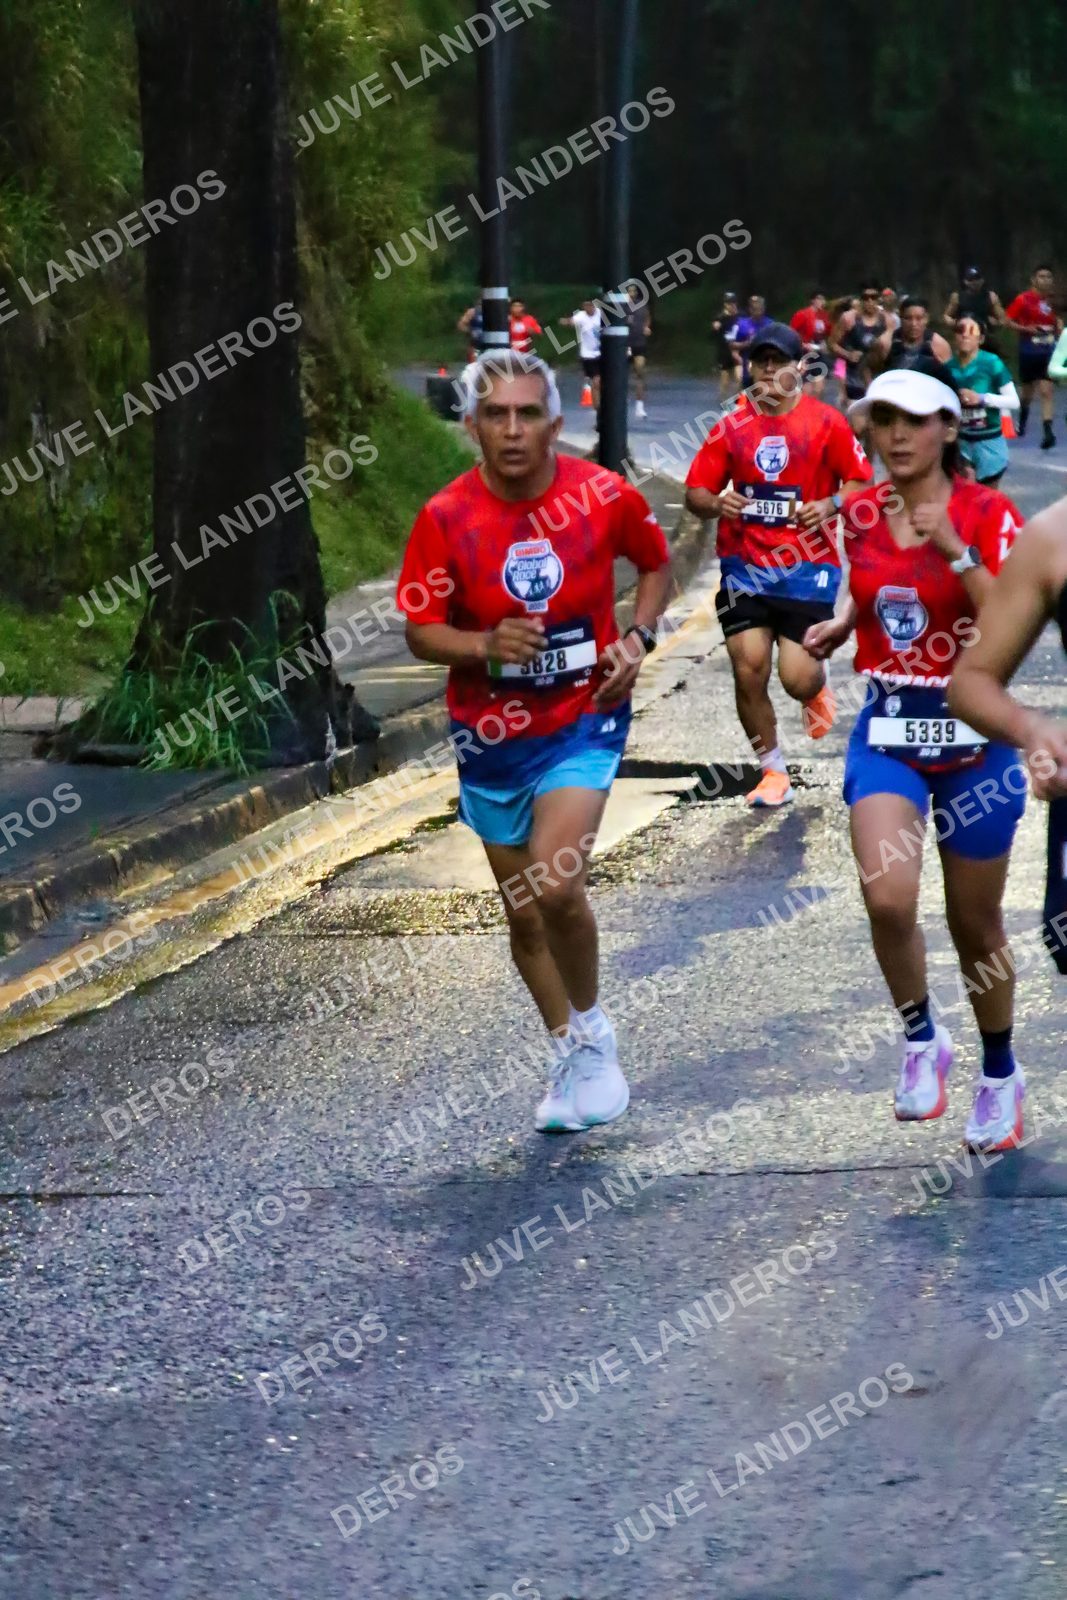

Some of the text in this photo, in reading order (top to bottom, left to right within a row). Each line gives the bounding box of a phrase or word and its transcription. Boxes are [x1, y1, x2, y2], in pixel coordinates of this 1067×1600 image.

[756, 501, 783, 515] 5676
[517, 558, 547, 571] Global
[512, 569, 537, 581] Race
[905, 720, 956, 744] 5339
